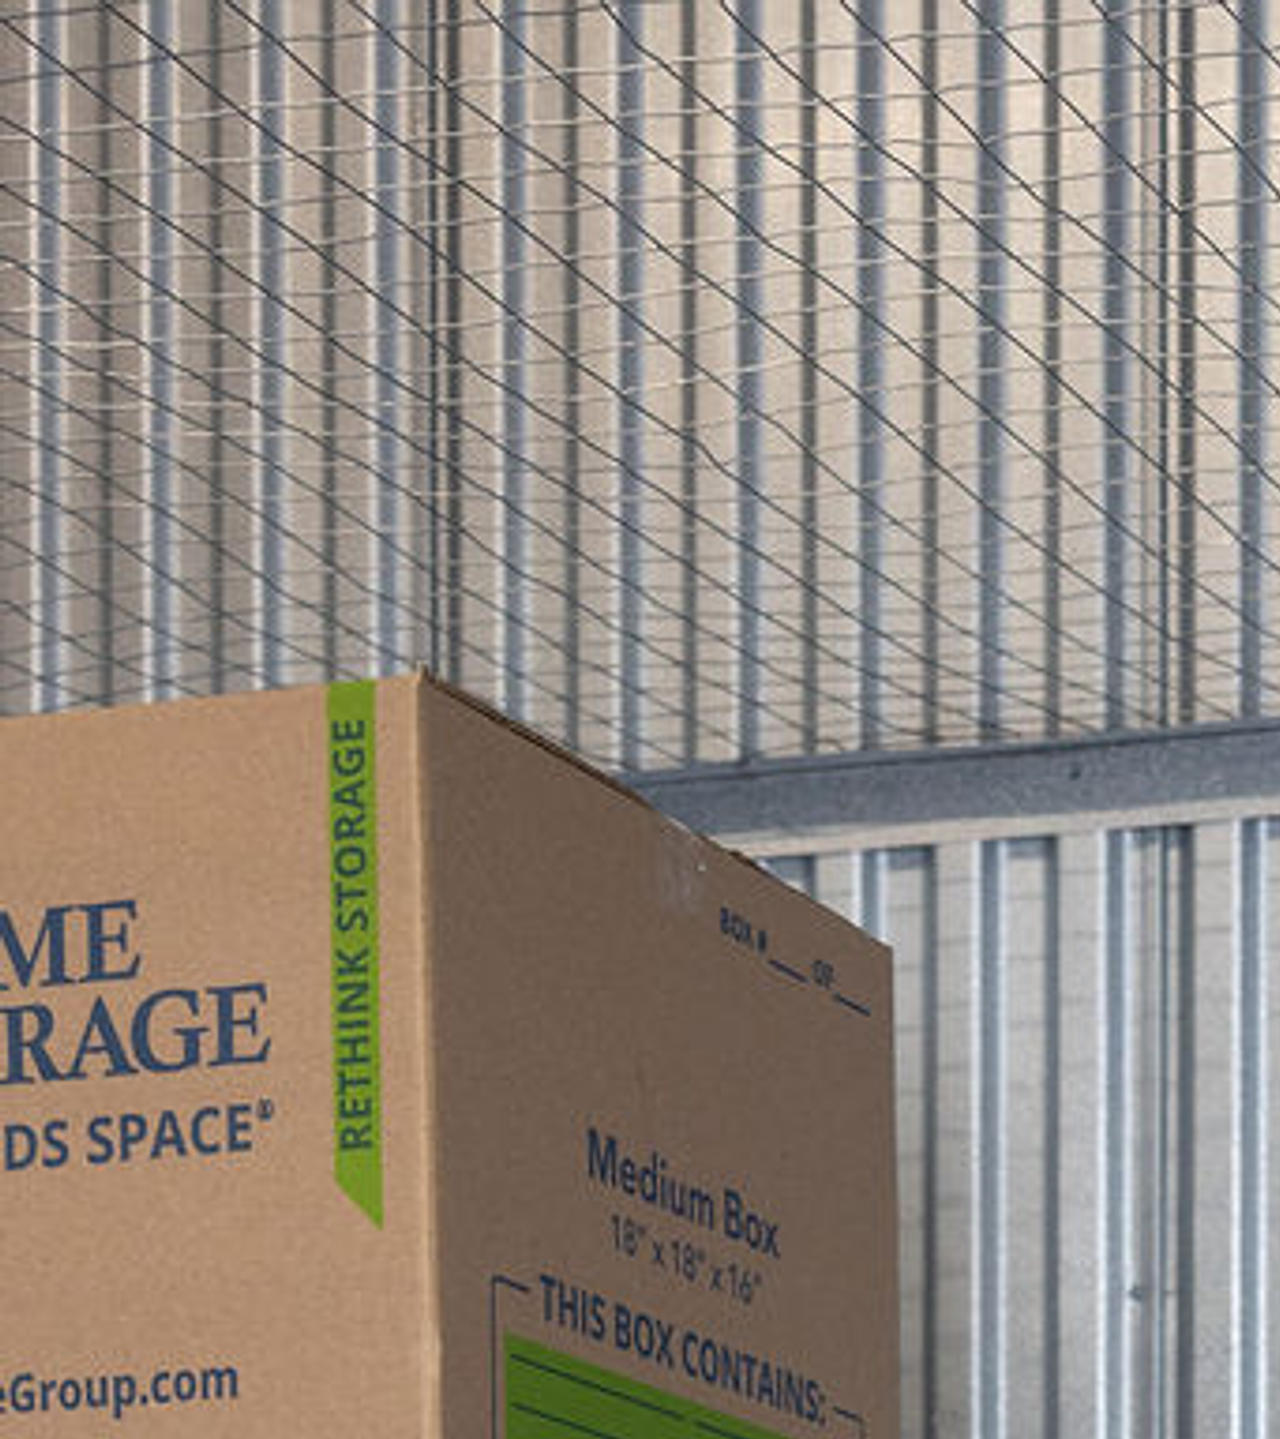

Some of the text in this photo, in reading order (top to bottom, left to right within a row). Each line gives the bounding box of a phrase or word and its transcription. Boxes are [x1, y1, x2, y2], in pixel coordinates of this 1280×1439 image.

[331, 719, 375, 1152] RETHINK STORAGE
[587, 1127, 780, 1259] Medium Box
[0, 1367, 238, 1420] Group.com
[539, 1274, 826, 1427] THIS BOX CONTAINS:
